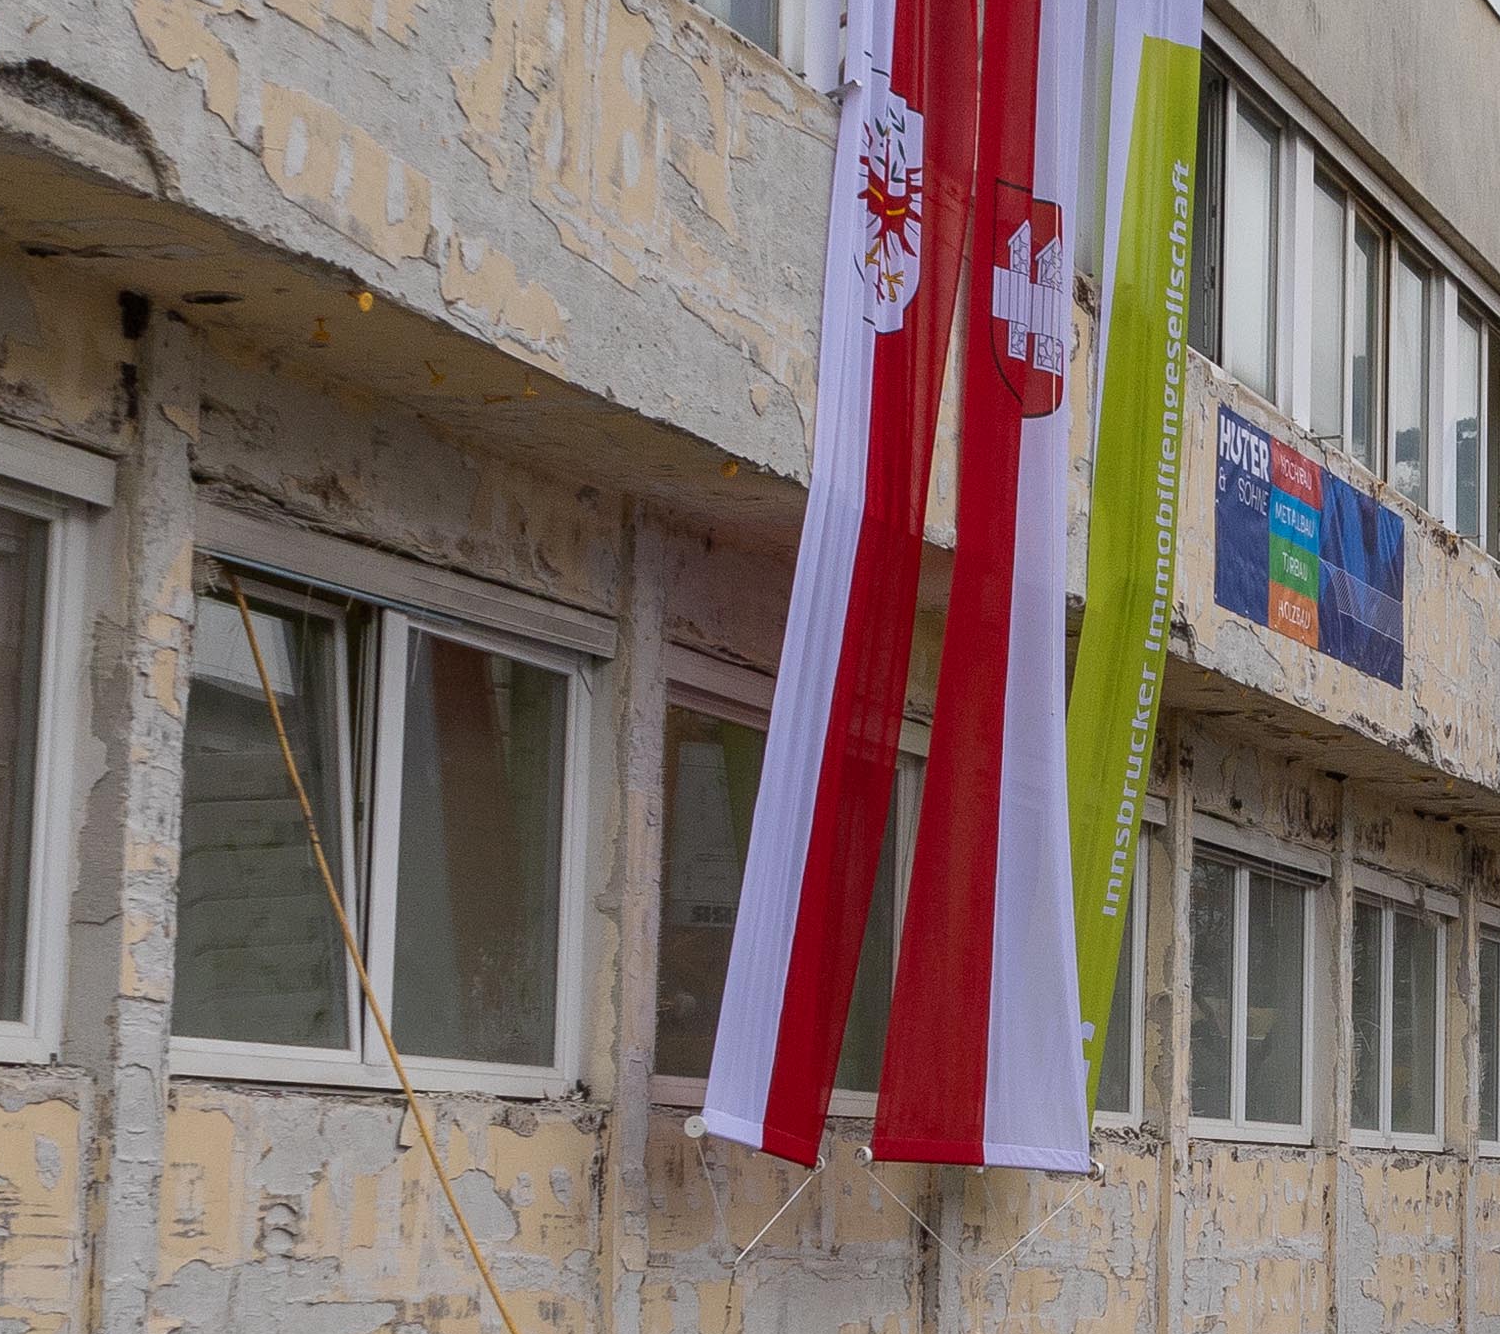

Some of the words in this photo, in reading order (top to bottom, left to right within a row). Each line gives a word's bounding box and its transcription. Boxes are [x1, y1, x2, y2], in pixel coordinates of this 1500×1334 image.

[1220, 416, 1270, 482] HUTER
[1218, 466, 1227, 492] &
[1238, 473, 1268, 516] SÖHNE
[1279, 455, 1313, 491] HOCHBAU
[1275, 502, 1315, 538] METALLBAU
[1278, 599, 1311, 630] HOLZBAU
